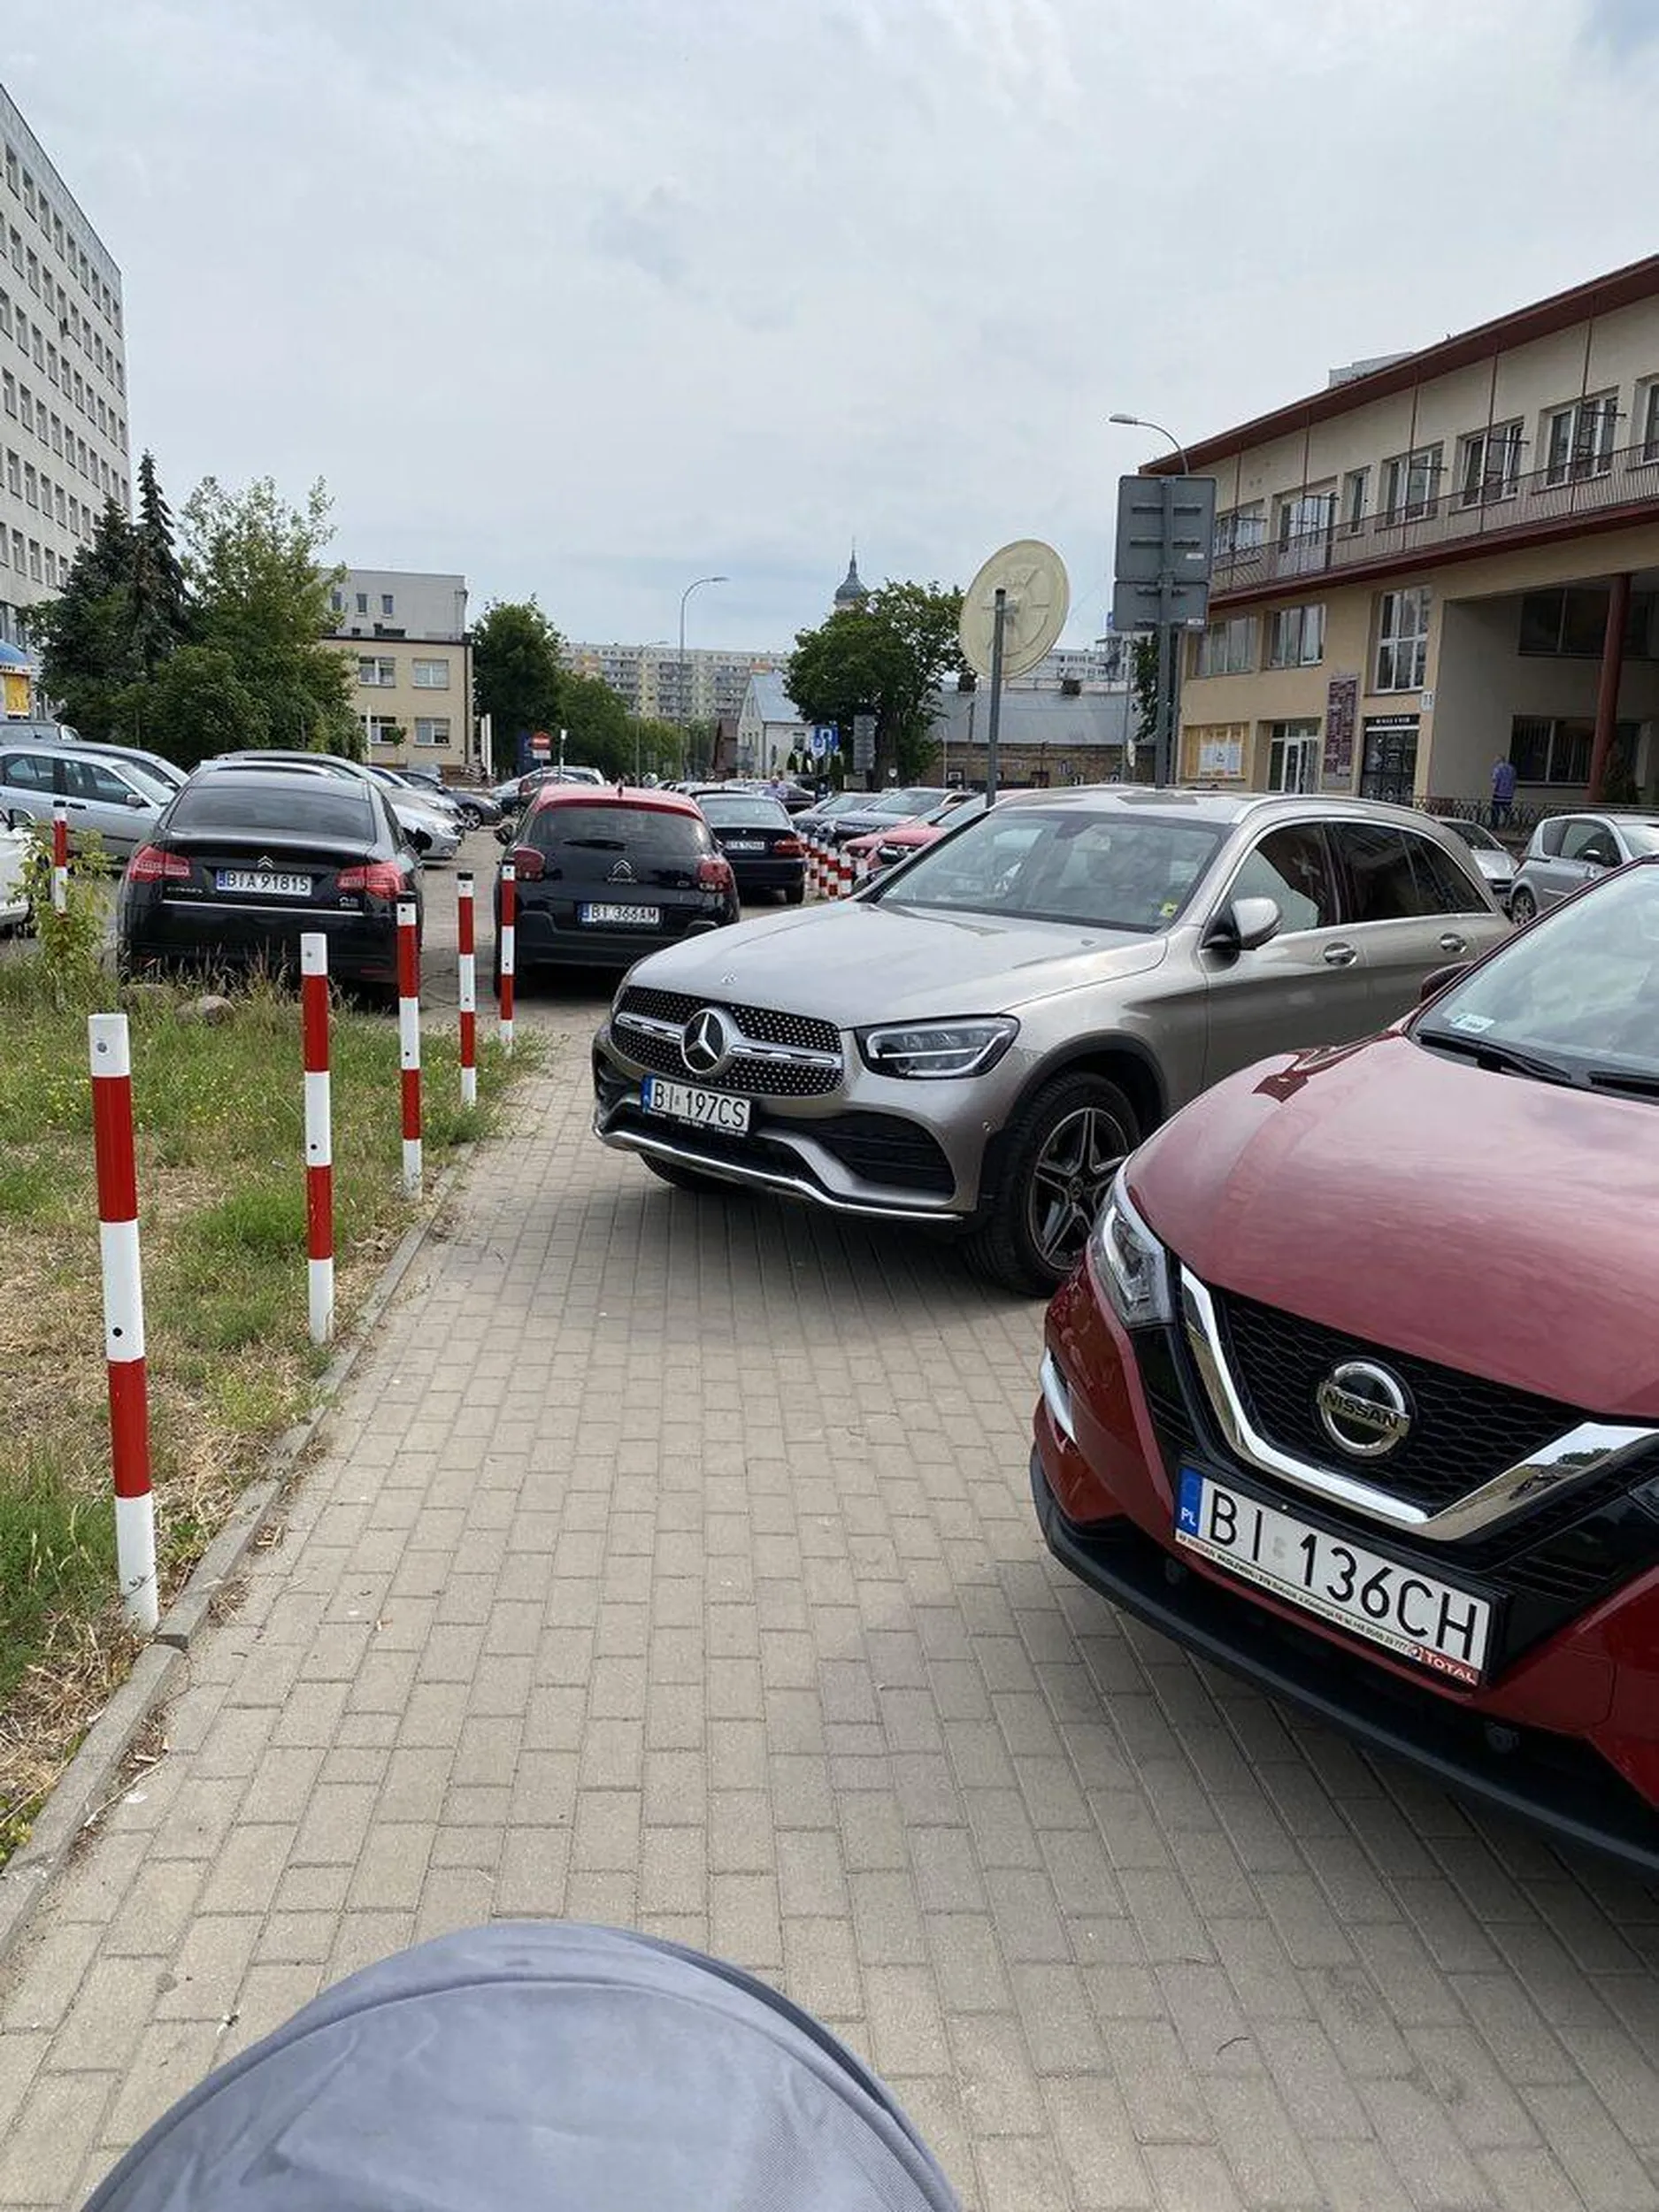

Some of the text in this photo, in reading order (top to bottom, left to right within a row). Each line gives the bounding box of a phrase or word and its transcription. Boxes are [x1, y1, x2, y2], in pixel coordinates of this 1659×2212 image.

[228, 871, 309, 892] BIA 91815
[592, 904, 607, 918] BI
[655, 1082, 674, 1110] BI
[687, 1090, 746, 1127] 197CS
[1323, 1389, 1399, 1429] NISSAN
[1180, 1506, 1196, 1526] PL
[1209, 1488, 1478, 1663] BI 136CH
[1424, 1651, 1478, 1686] TOTAL
